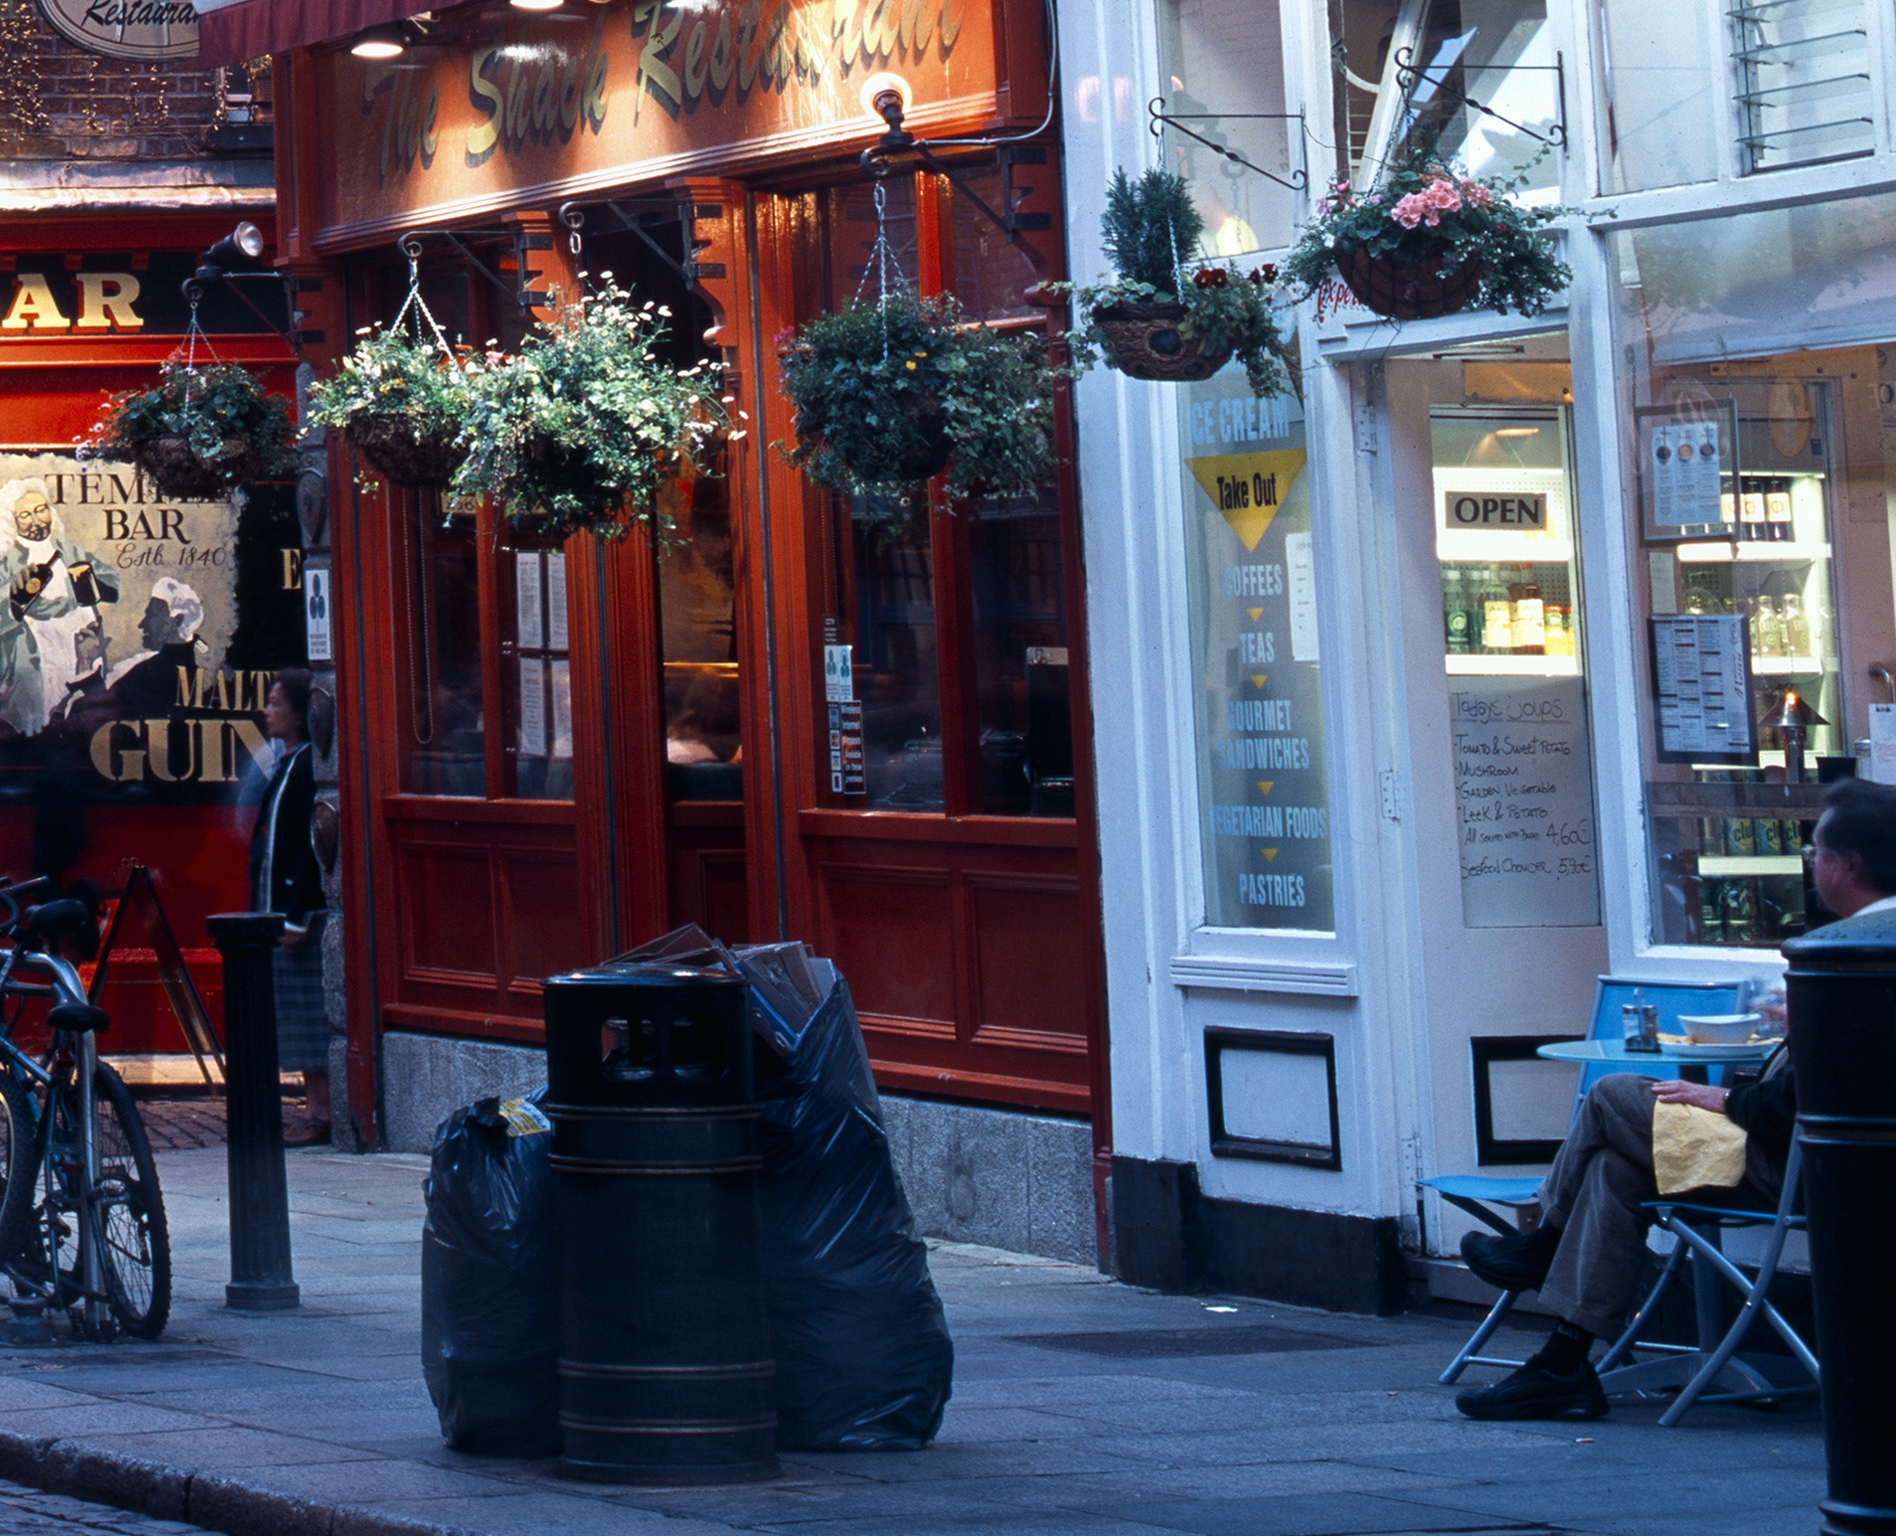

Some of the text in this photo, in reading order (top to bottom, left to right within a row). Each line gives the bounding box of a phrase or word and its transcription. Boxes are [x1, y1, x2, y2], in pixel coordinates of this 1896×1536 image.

[363, 59, 440, 189] The
[466, 0, 610, 169] Shack
[1219, 394, 1290, 443] CREAM
[1217, 472, 1277, 510] Take Out
[103, 508, 192, 544] BAR
[1455, 497, 1539, 524] OPEN
[177, 545, 228, 568] 1840
[1224, 565, 1283, 597] COFFEES
[1239, 633, 1275, 664] TEAS
[1226, 700, 1291, 732] GOURMET
[90, 719, 275, 783] GUIN
[1218, 739, 1309, 770] SANDWICHES
[1285, 807, 1326, 839] FOODS
[1239, 874, 1305, 908] PASTRIES
